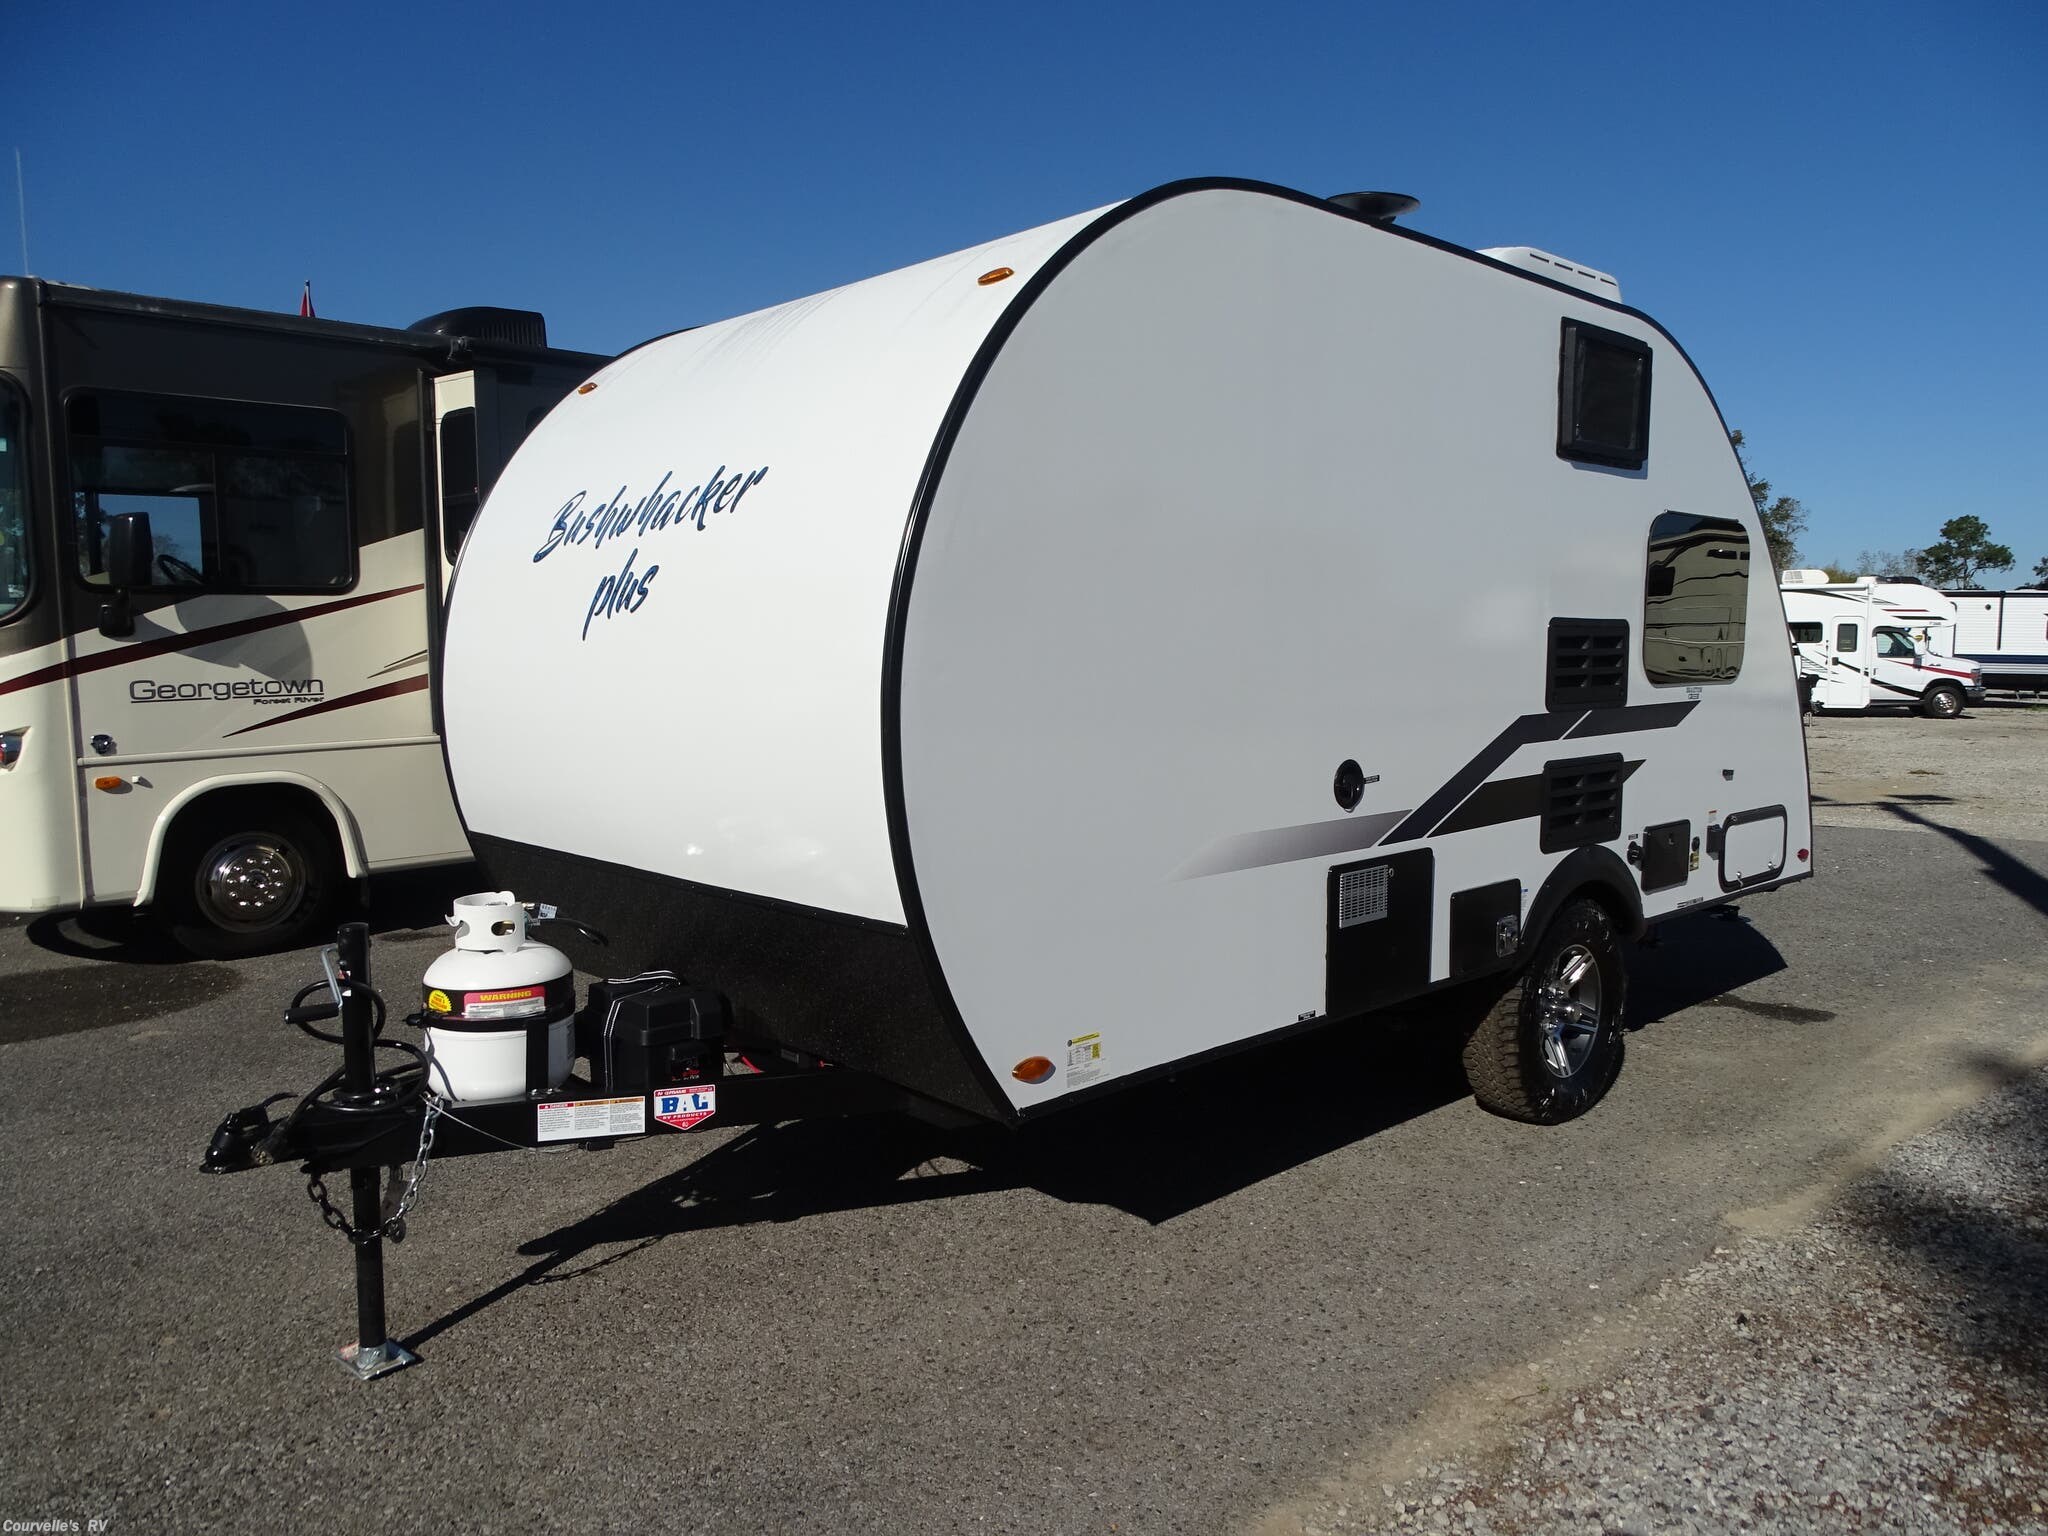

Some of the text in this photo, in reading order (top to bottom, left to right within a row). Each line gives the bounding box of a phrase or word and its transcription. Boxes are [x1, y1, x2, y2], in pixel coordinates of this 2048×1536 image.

[533, 465, 769, 563] Bushwhacker
[582, 548, 659, 641] plus
[129, 678, 325, 701] Georgetown
[253, 696, 325, 705] Forest River
[480, 990, 532, 1001] WARNING
